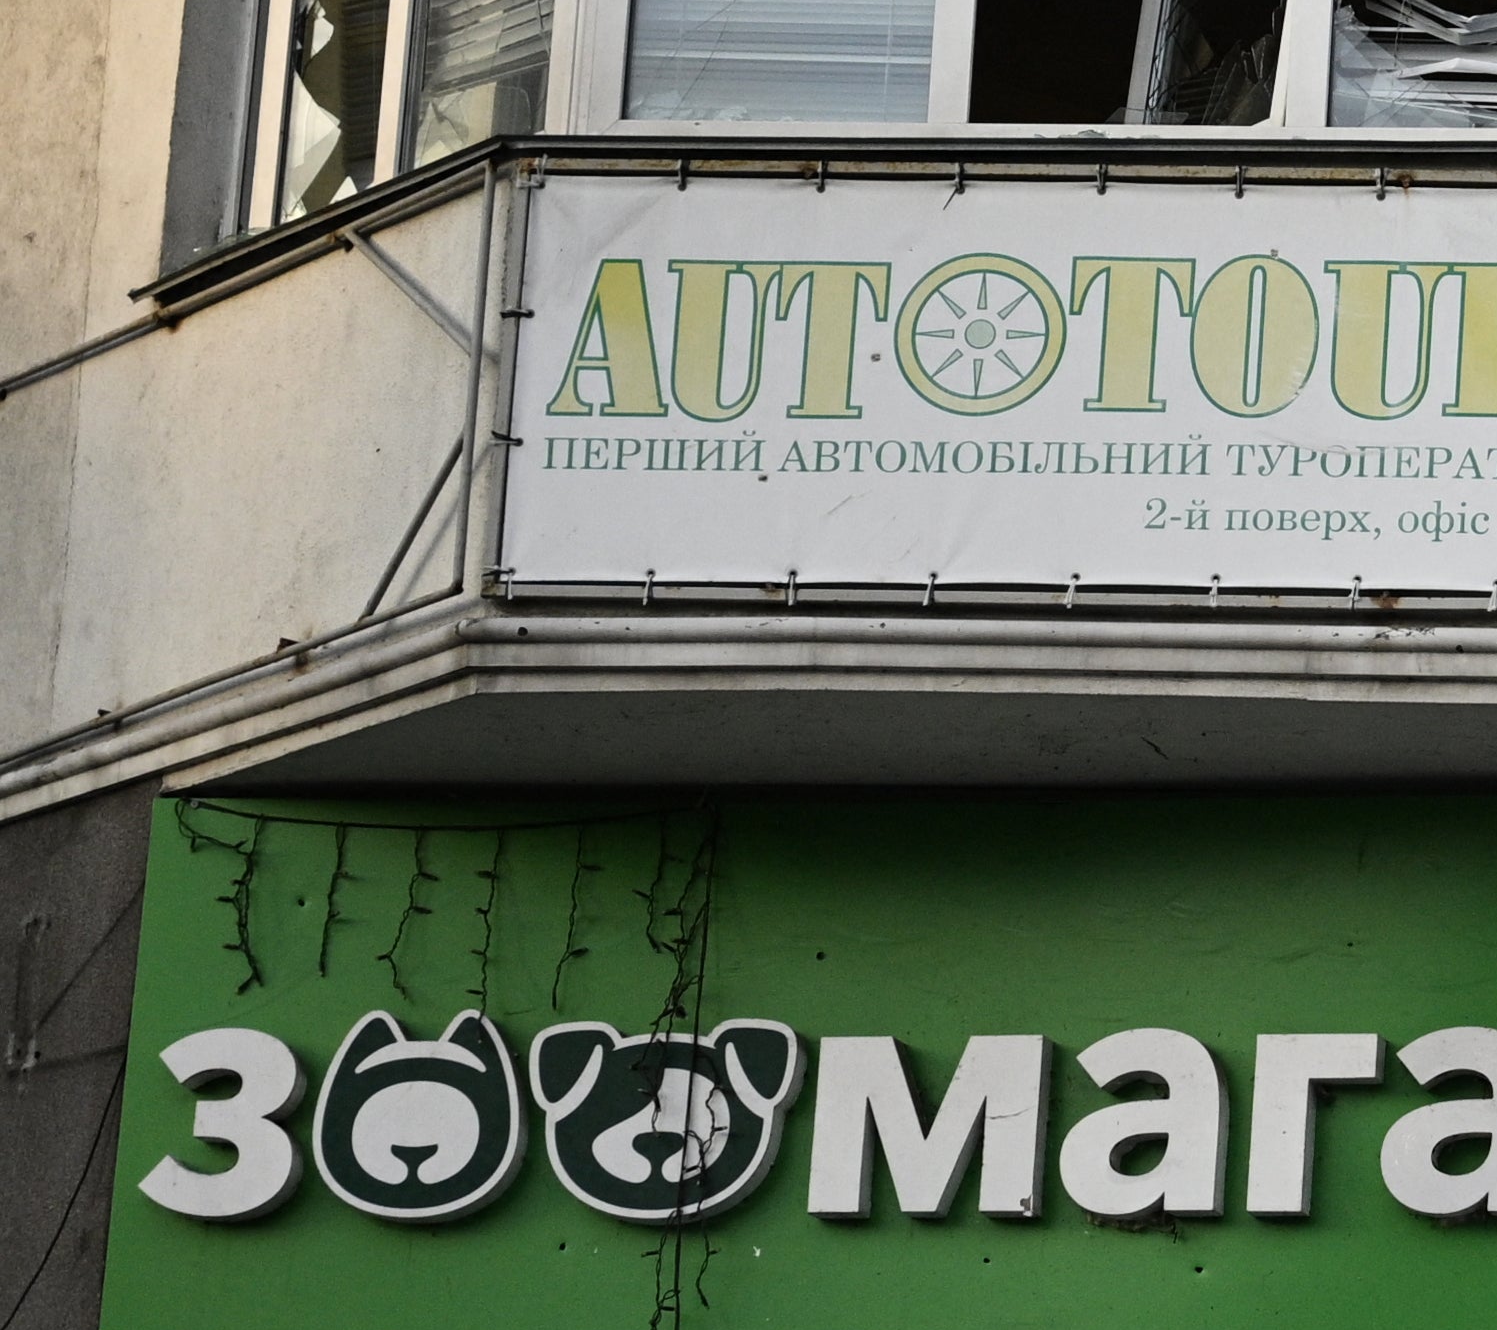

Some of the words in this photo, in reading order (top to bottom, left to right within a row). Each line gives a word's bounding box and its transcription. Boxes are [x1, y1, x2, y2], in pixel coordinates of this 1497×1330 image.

[542, 430, 763, 473] ПЕРШИЙ
[779, 433, 1209, 475] АВТОМОБІЛЬНИЙ
[1143, 495, 1211, 533] 2-й
[1224, 504, 1382, 539] поверх,
[1399, 497, 1490, 541] офіс
